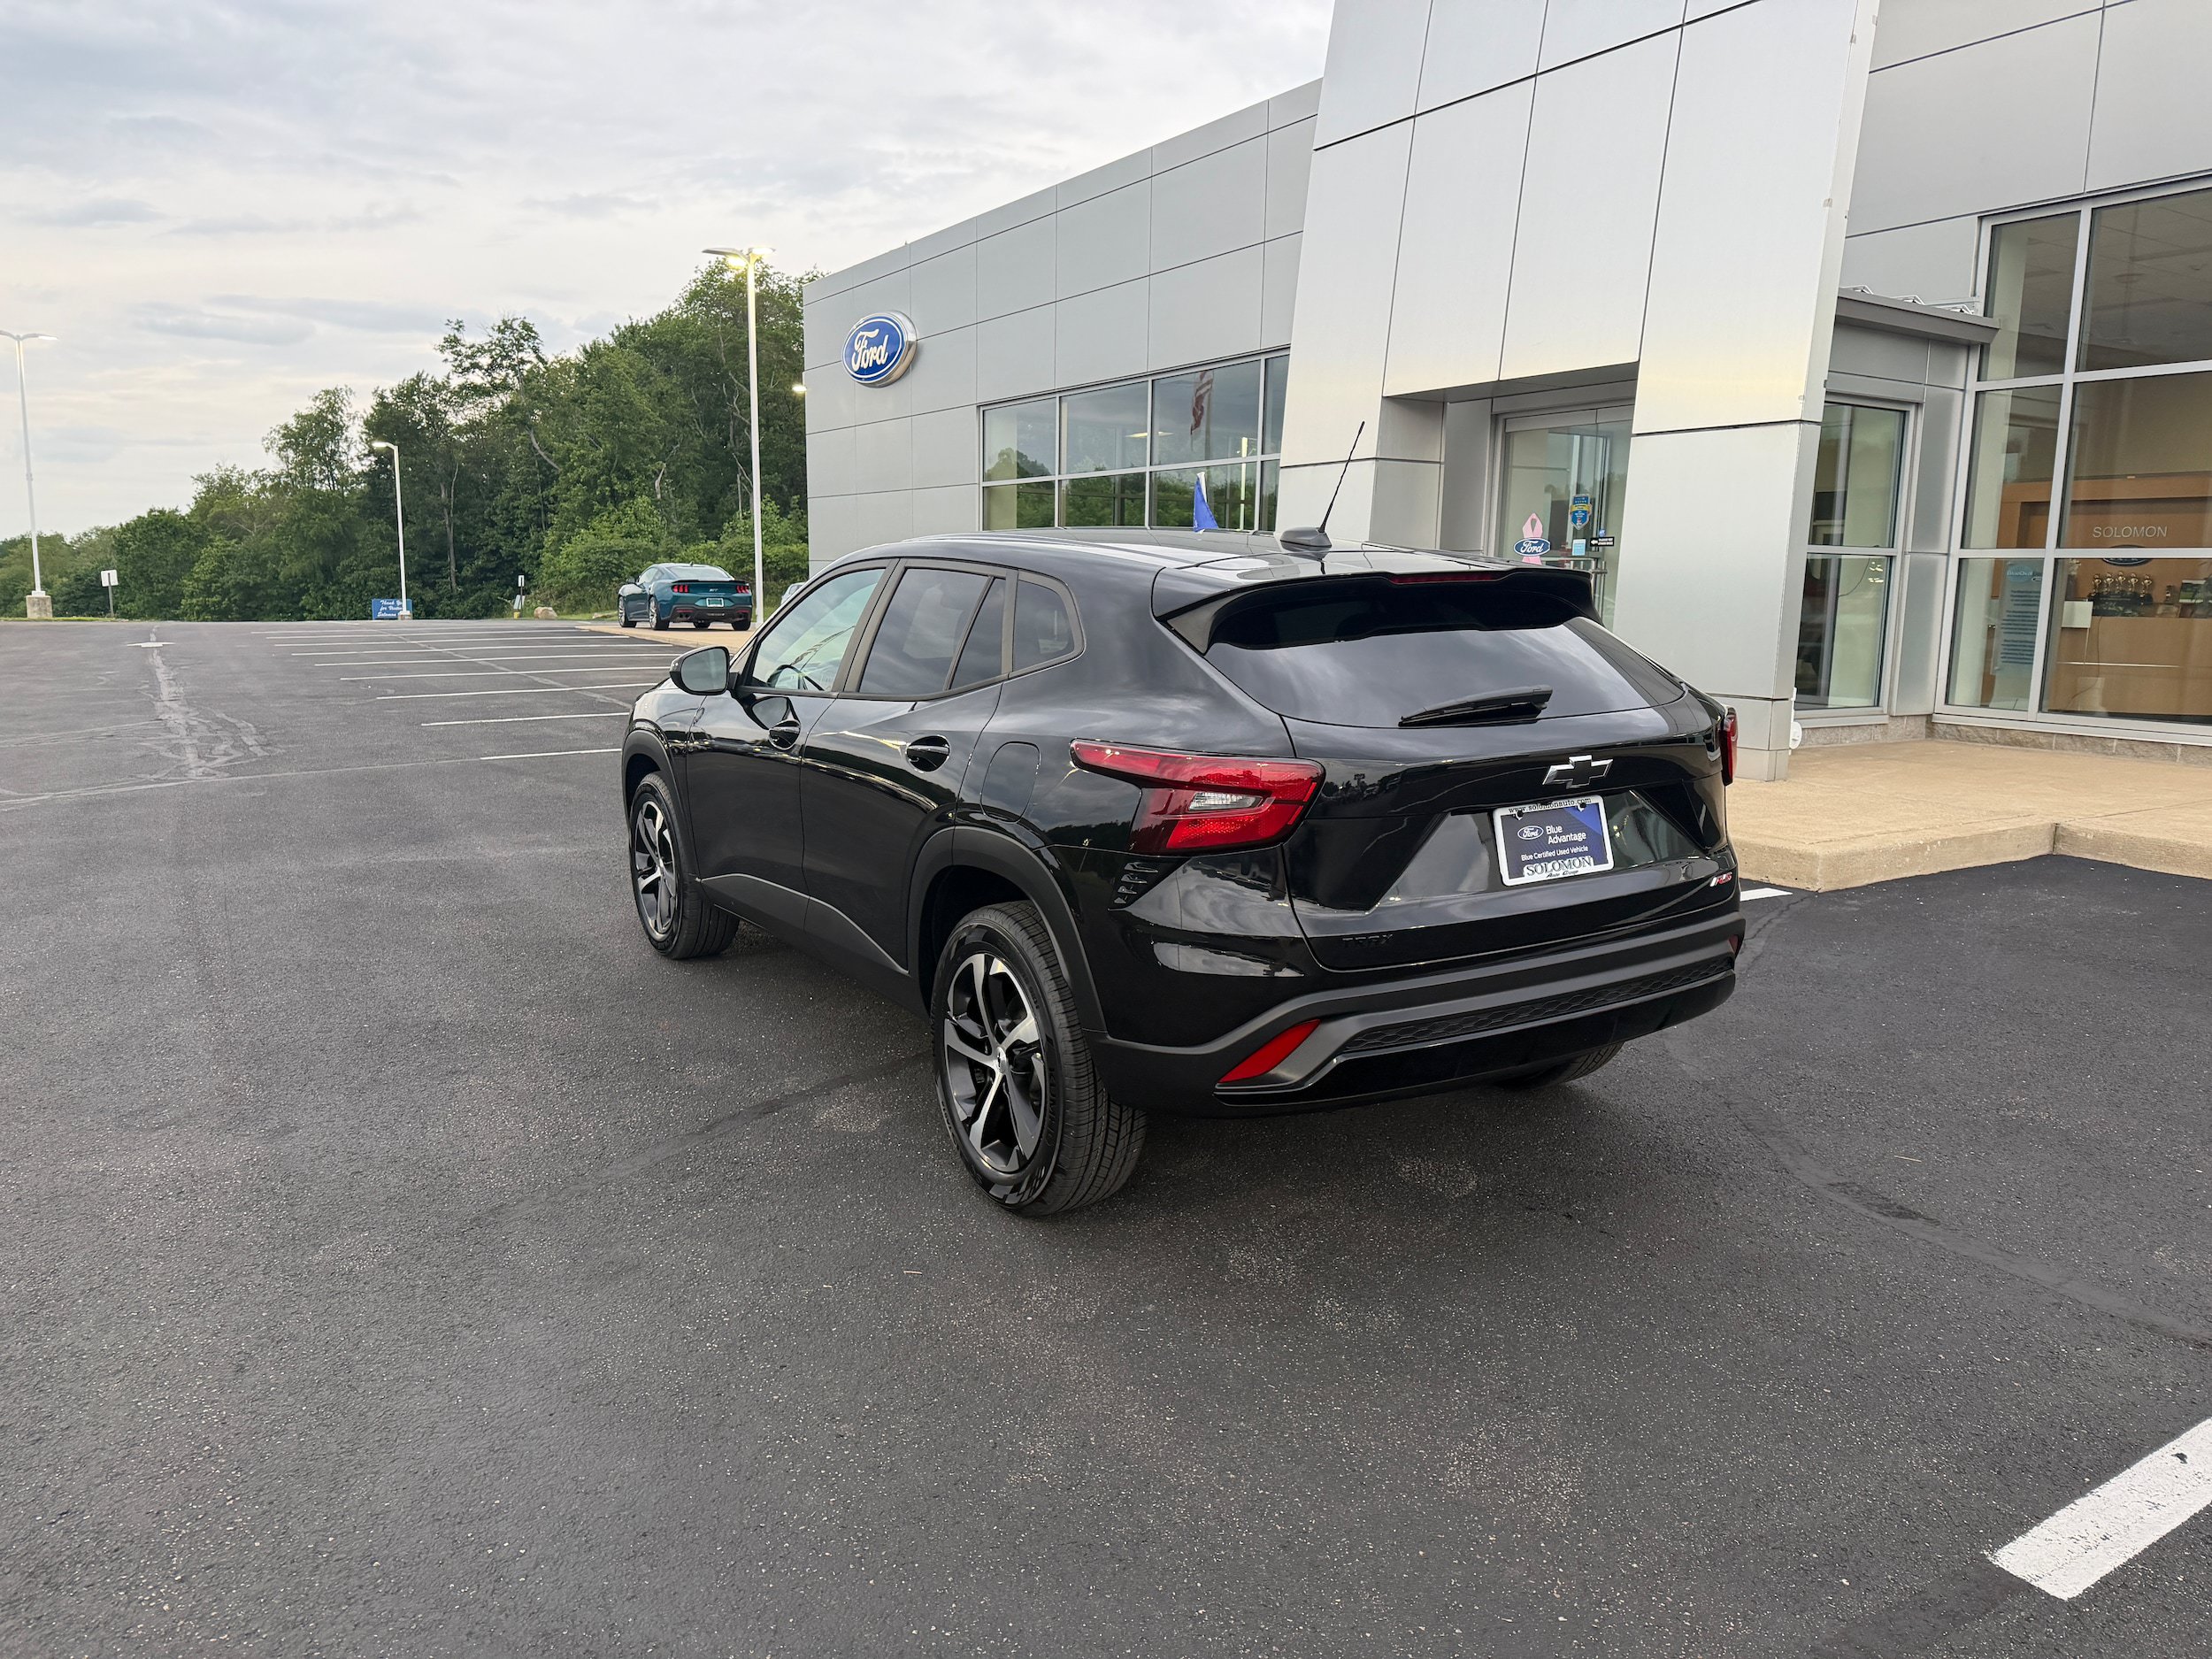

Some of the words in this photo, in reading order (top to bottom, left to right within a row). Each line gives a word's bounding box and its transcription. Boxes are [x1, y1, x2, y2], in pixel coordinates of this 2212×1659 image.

[851, 328, 888, 372] Ford
[2093, 526, 2168, 538] SOLOMON
[1520, 540, 1544, 553] Ford
[1522, 827, 1539, 838] Ford
[1545, 825, 1563, 835] Blue
[1548, 832, 1586, 845] Advantage
[1533, 850, 1555, 859] Certified
[1556, 848, 1570, 856] Used
[1570, 845, 1589, 854] Vehicle
[1526, 856, 1592, 876] SOLOMON
